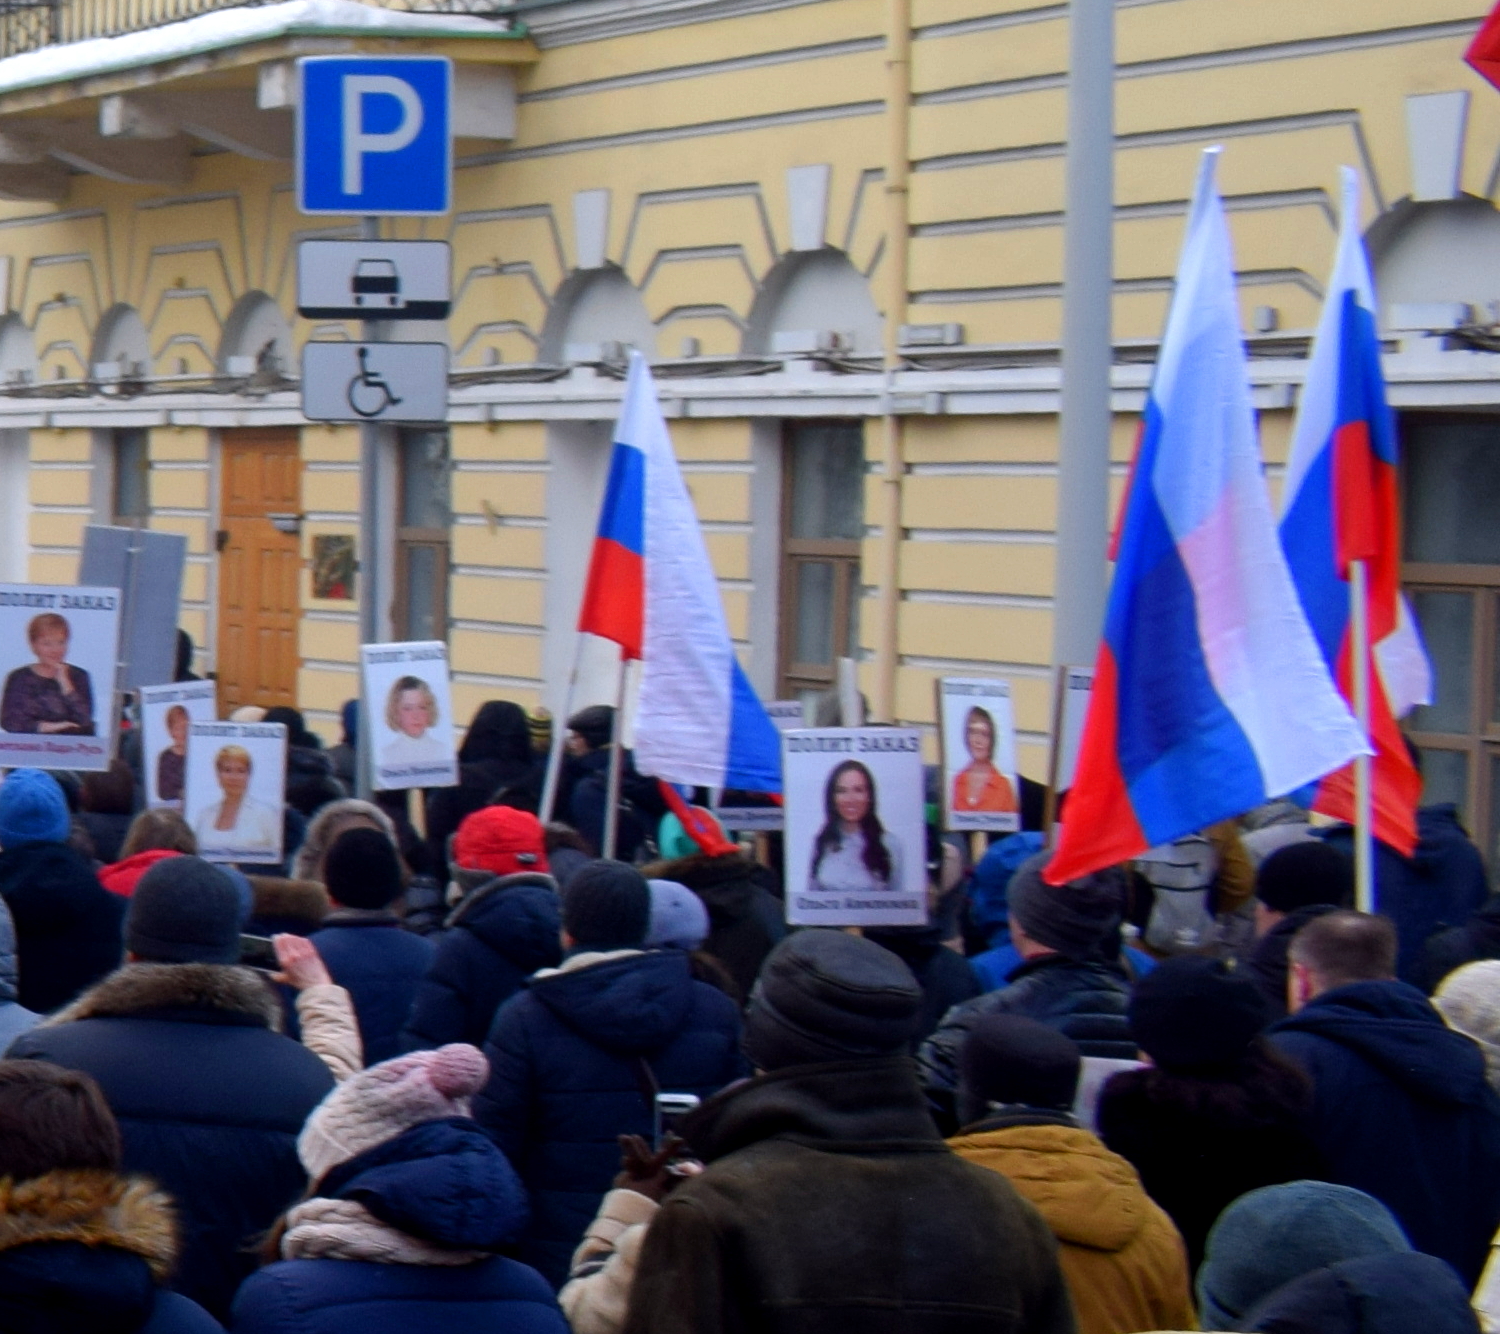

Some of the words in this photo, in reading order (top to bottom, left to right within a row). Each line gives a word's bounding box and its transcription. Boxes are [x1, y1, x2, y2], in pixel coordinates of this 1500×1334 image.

[342, 74, 424, 196] P
[60, 595, 116, 610] ЗАКАЗ
[786, 737, 851, 752] ПОЛИТ
[858, 737, 919, 752] ЗАКАЗ
